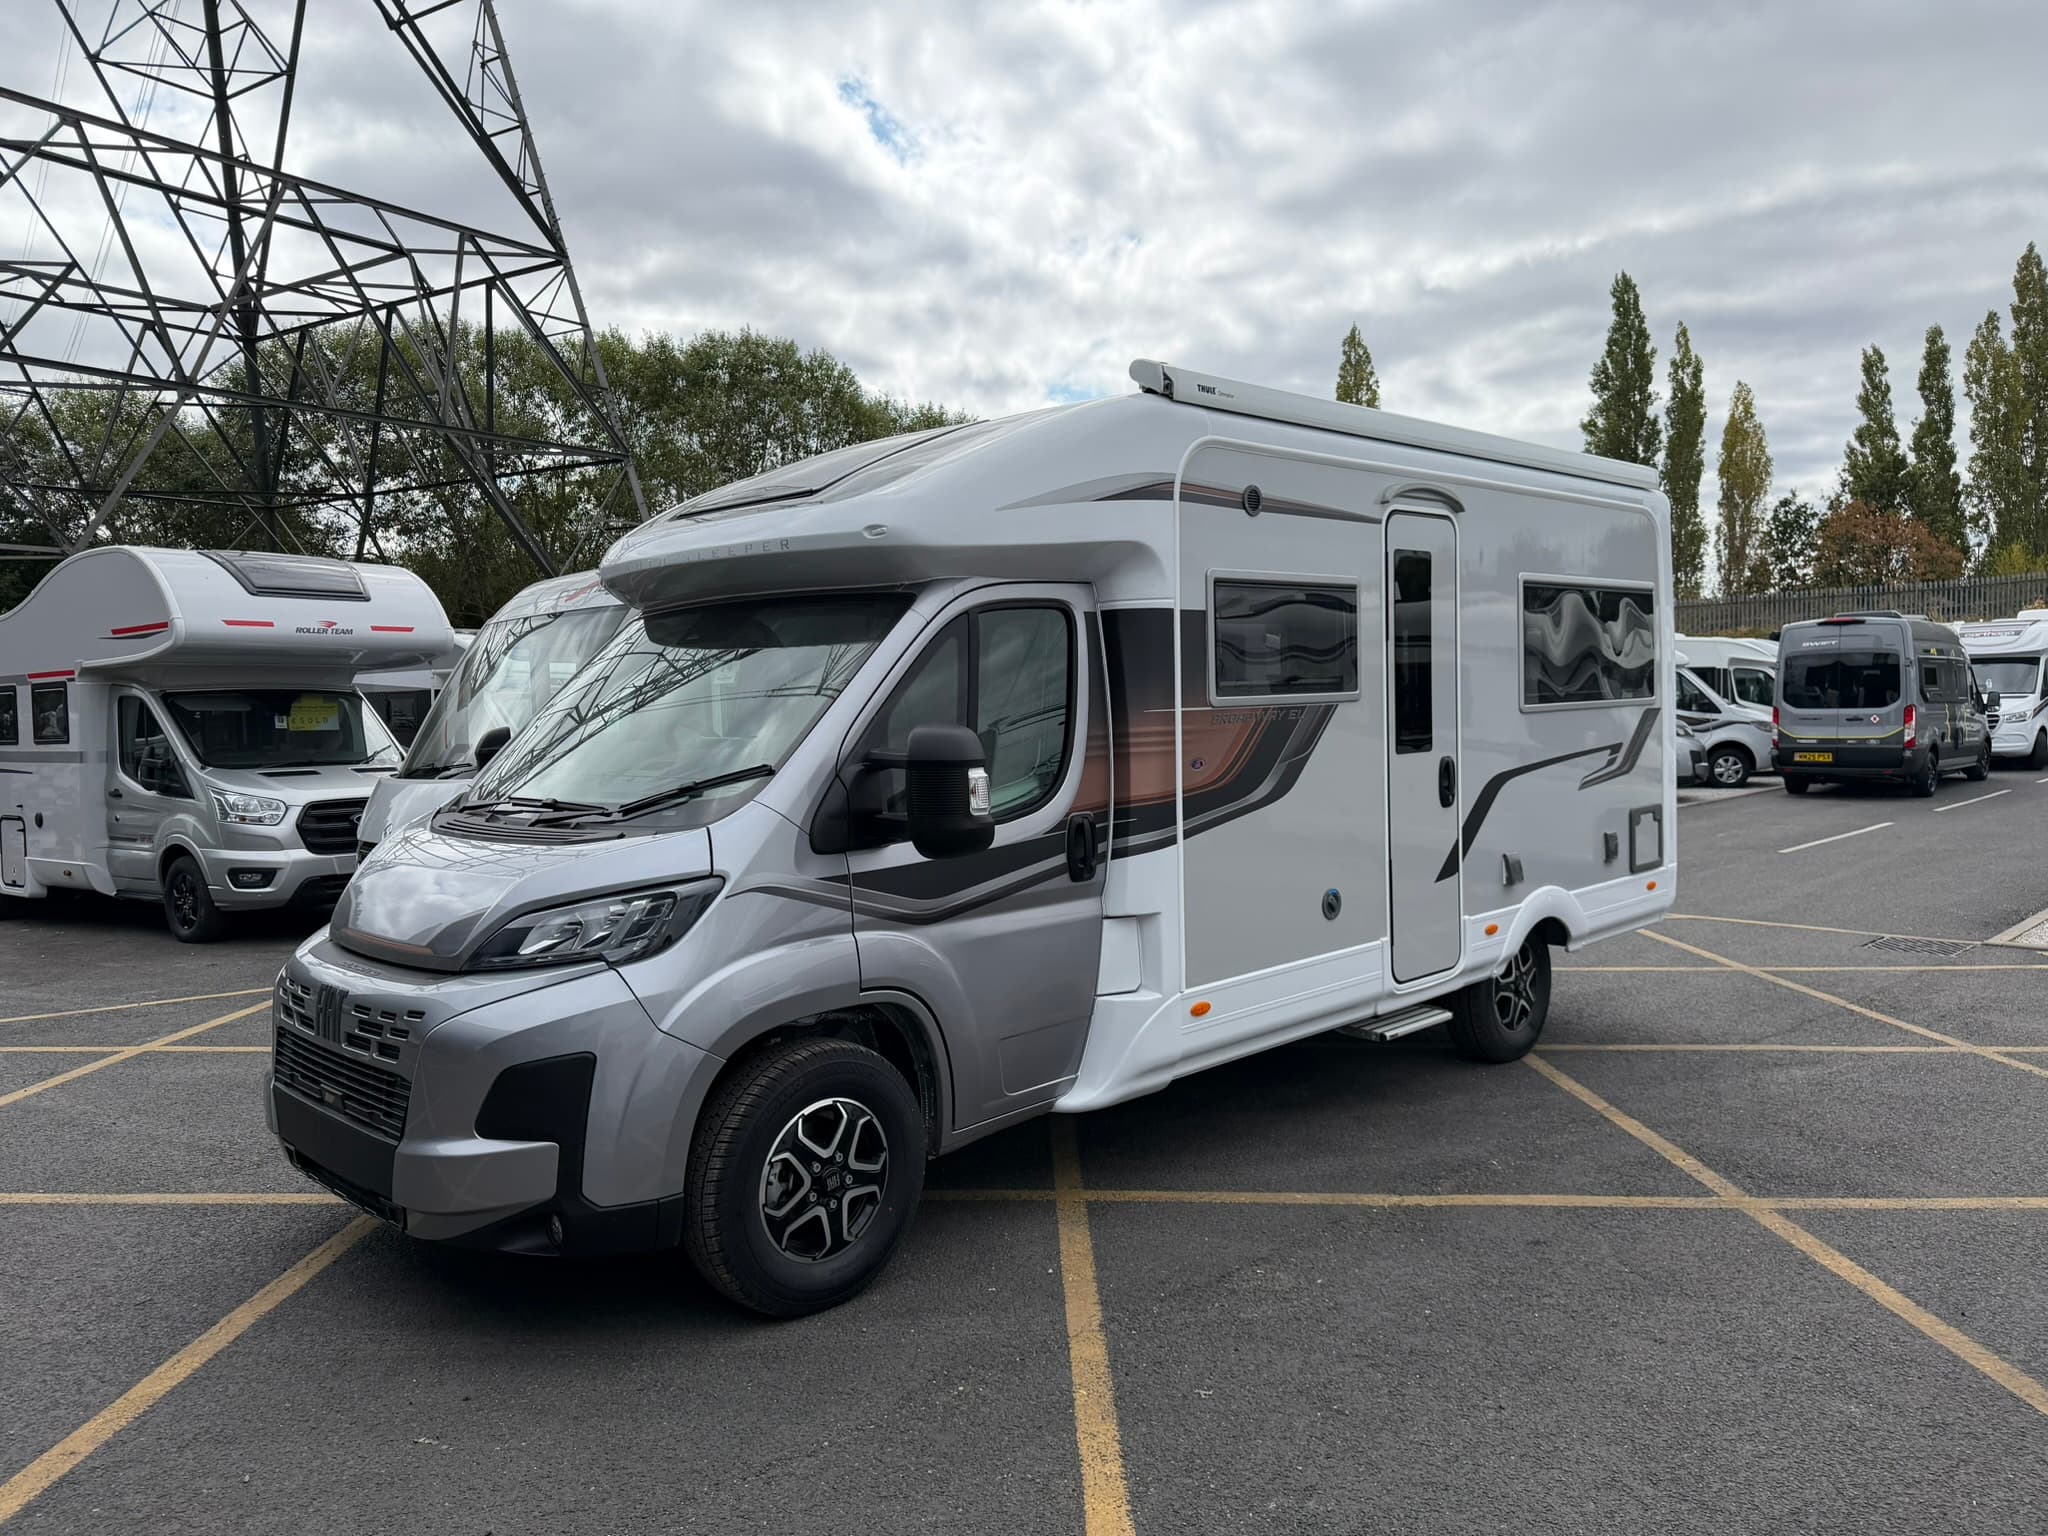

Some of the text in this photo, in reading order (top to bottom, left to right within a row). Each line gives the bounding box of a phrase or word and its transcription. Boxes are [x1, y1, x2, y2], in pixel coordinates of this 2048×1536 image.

[1197, 384, 1216, 395] THULE
[295, 626, 329, 634] ROLLER
[1801, 640, 1839, 648] SWIFT
